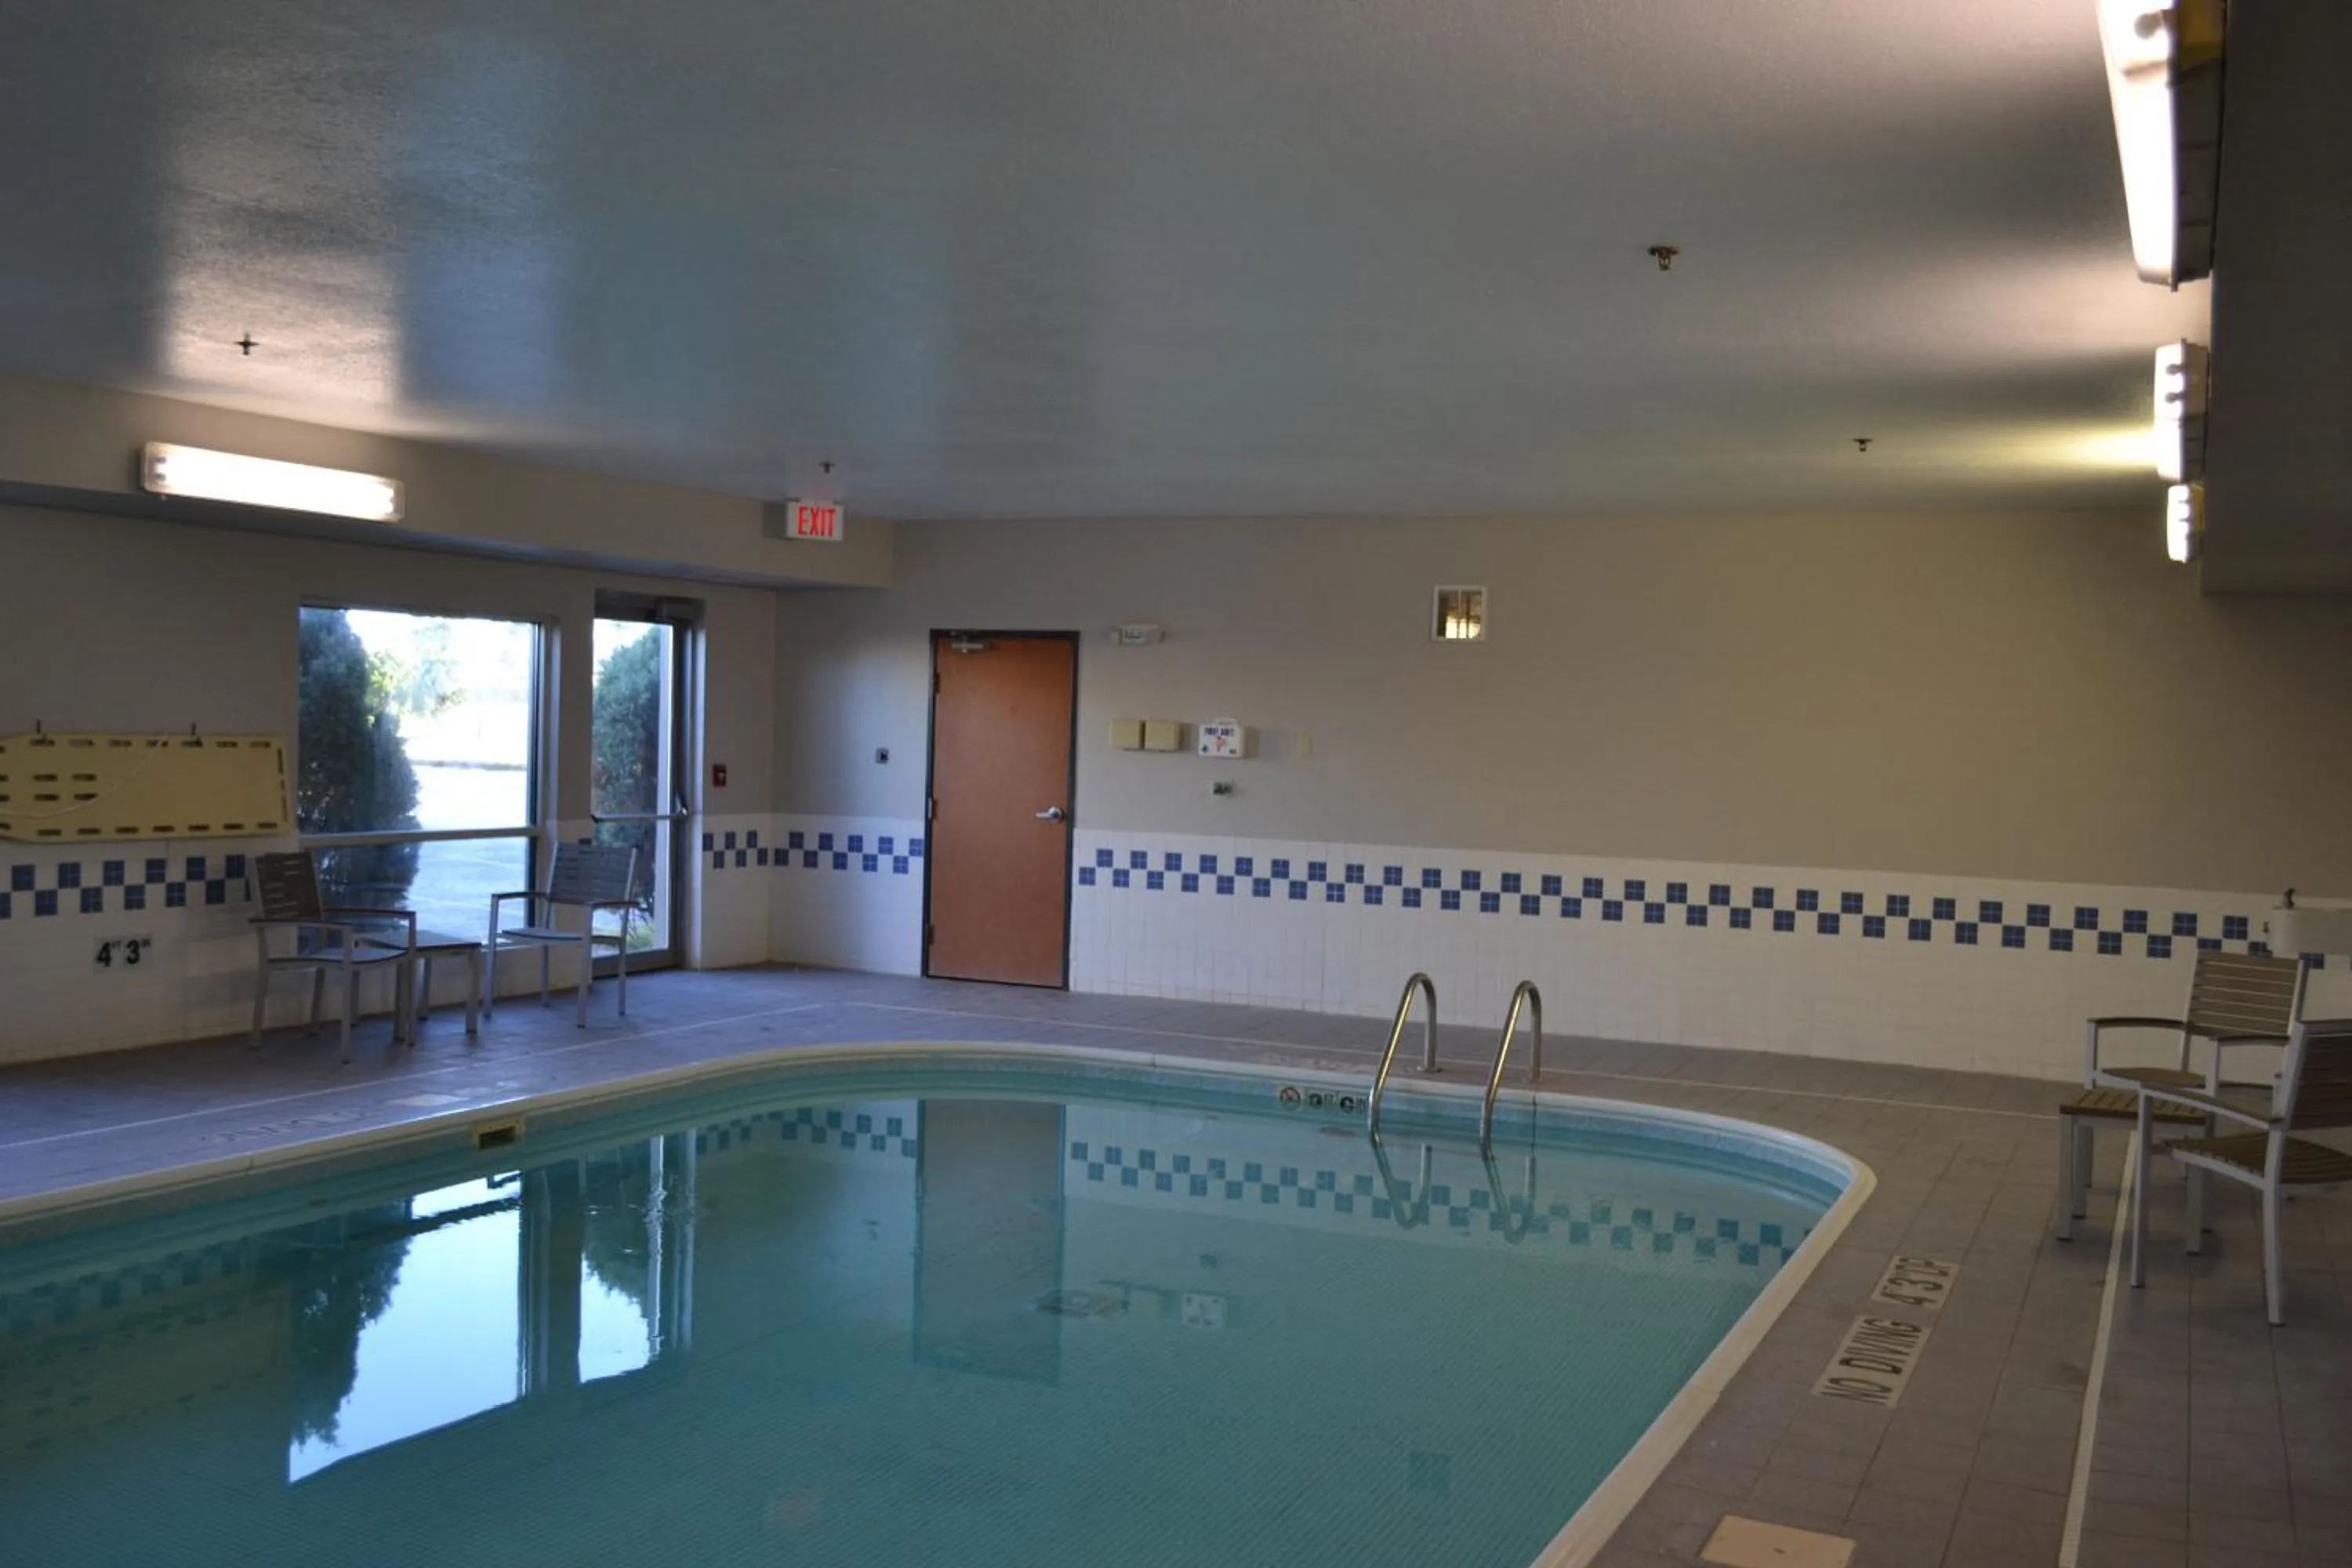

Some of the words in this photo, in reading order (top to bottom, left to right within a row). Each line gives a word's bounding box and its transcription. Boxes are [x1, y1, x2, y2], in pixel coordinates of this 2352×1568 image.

[797, 504, 837, 538] EXIT
[1838, 1317, 1922, 1375] DIVING
[1819, 1377, 1893, 1406] NO
